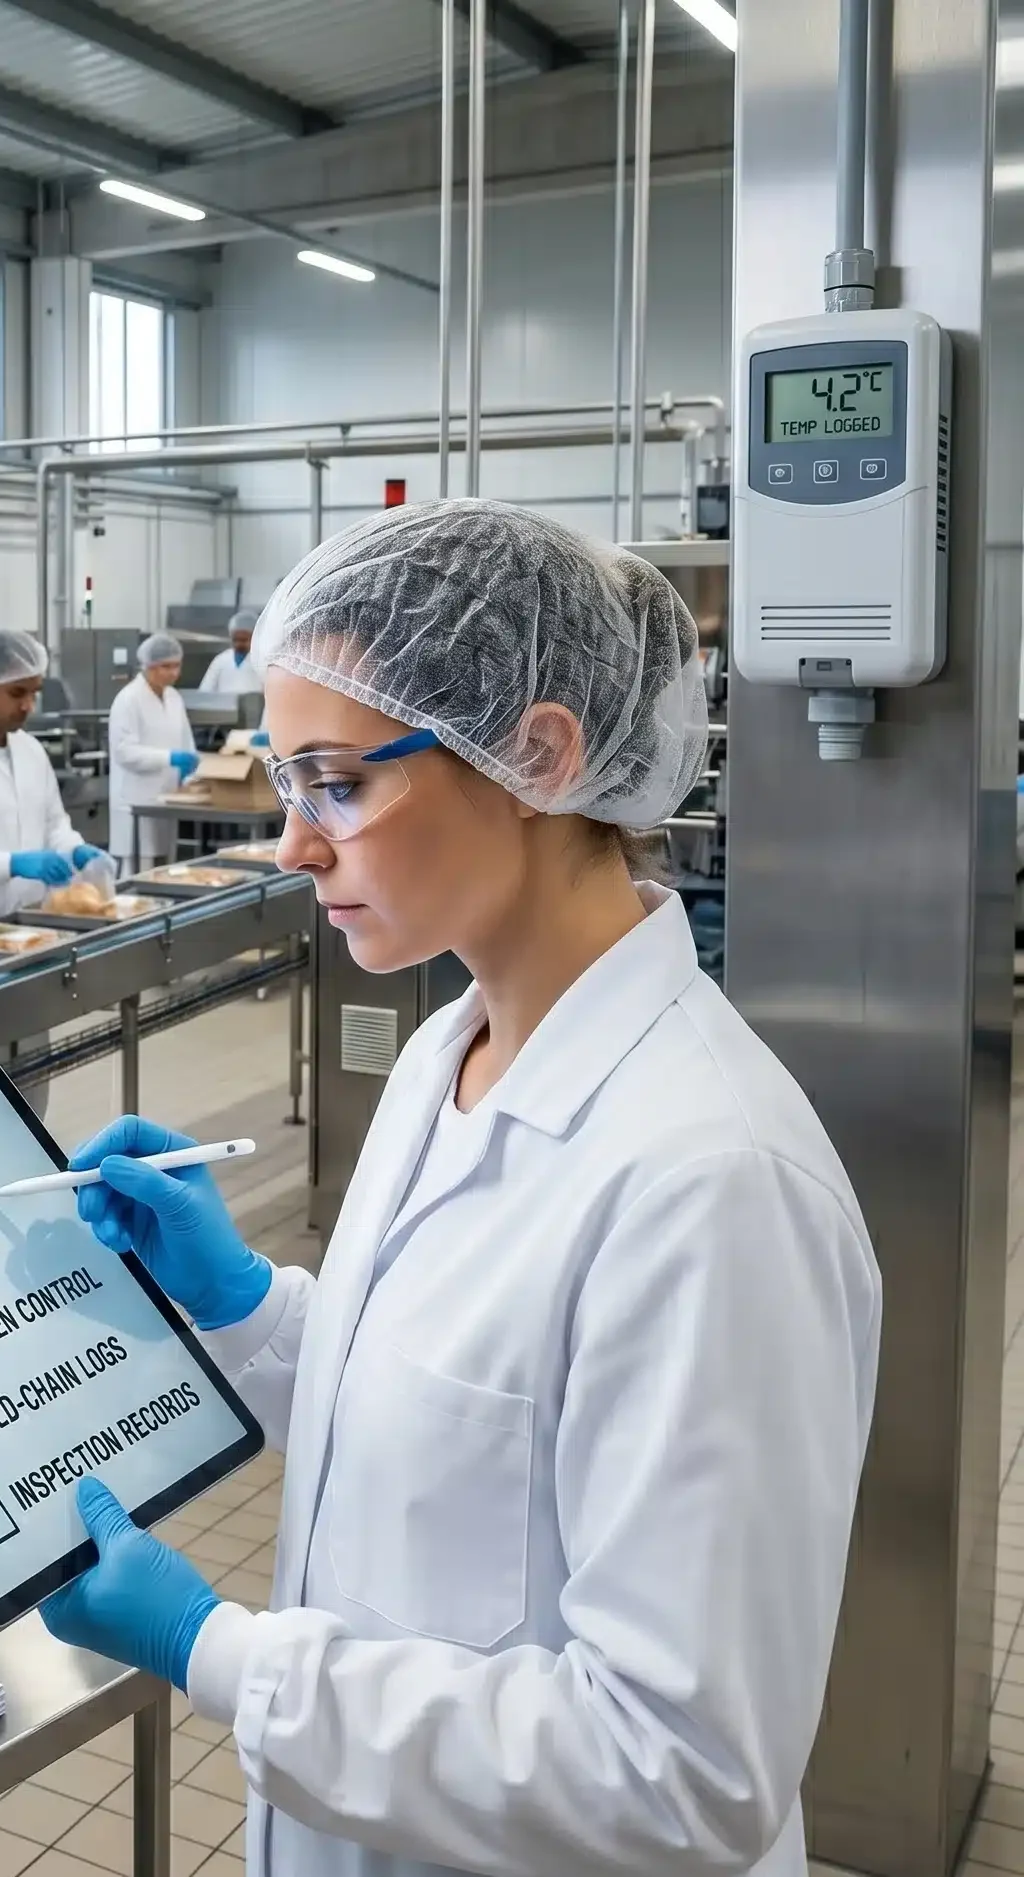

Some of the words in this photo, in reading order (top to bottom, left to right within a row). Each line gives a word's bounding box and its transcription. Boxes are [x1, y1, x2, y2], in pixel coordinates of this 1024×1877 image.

[781, 420, 817, 435] TEMP
[825, 417, 880, 433] LOGGED
[15, 1267, 103, 1323] CONTROL
[75, 1336, 128, 1379] LOGS
[8, 1427, 124, 1511] INSPECTION
[116, 1381, 201, 1446] RECORDS
